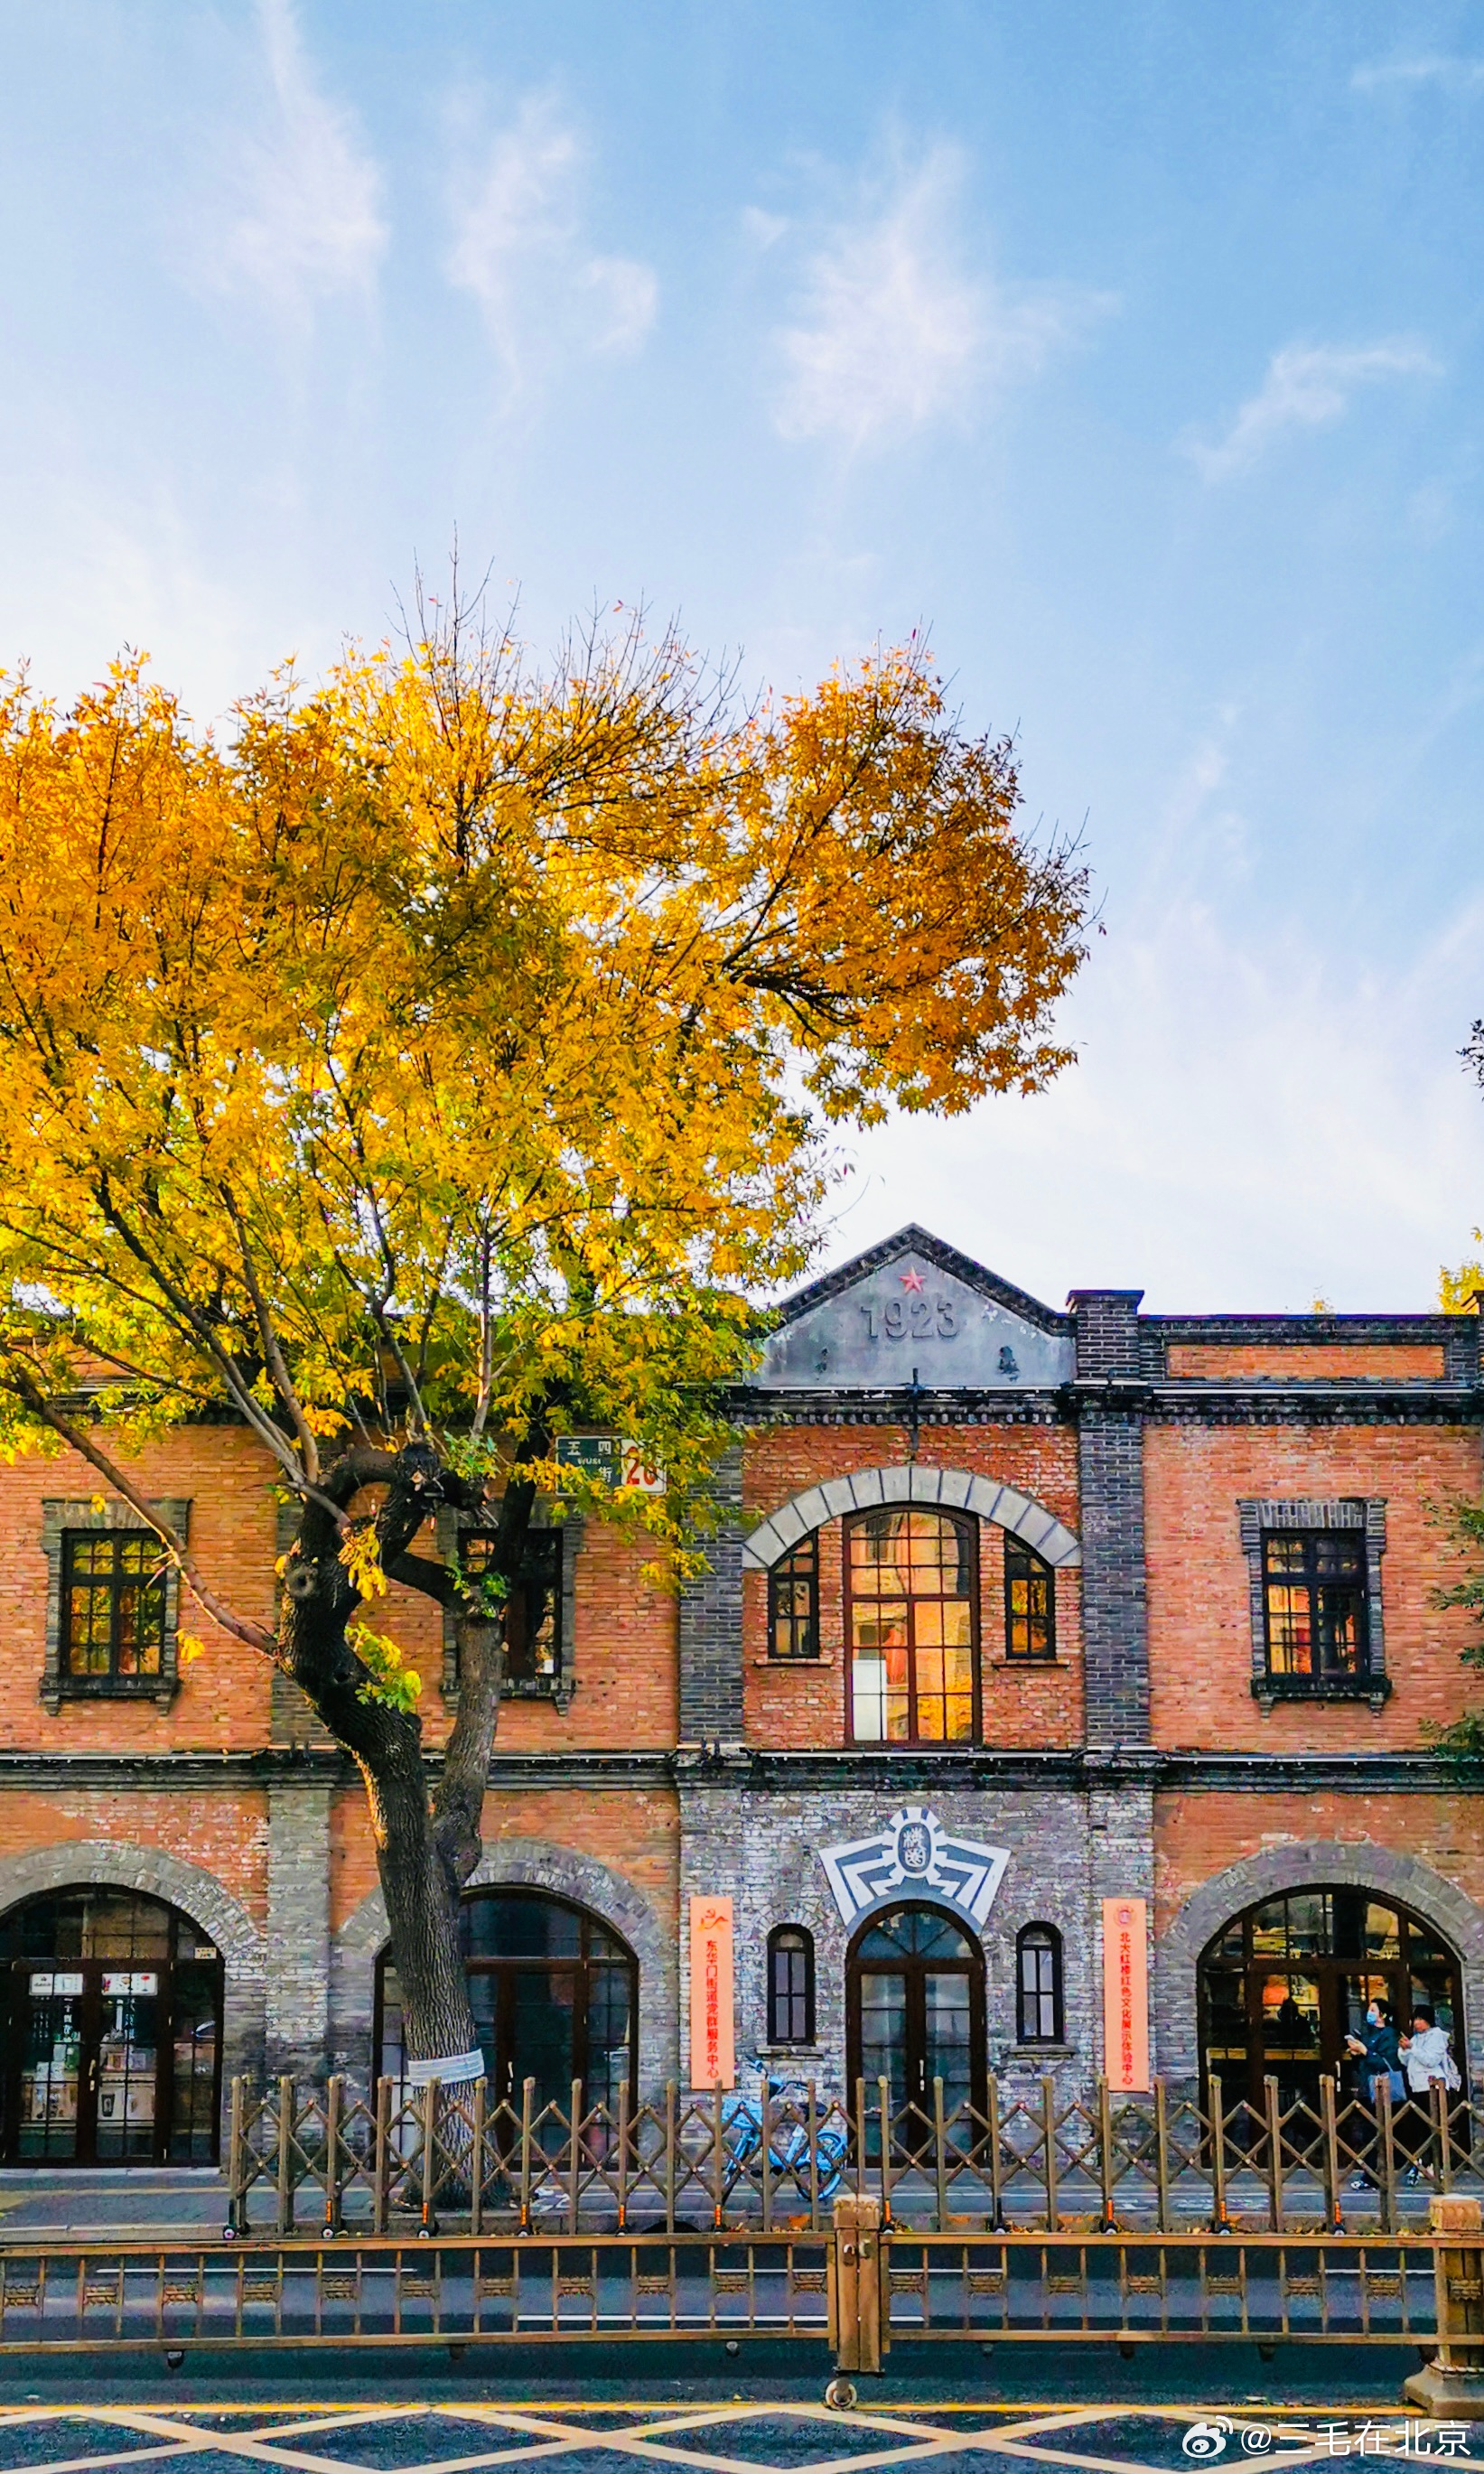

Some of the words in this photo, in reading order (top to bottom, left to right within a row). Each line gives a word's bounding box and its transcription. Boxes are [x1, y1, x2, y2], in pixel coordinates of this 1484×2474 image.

[860, 1299, 959, 1338] 1923
[567, 1441, 611, 1456] 五四
[705, 1939, 720, 2079] 东华门街道党群服务中心
[1119, 1932, 1134, 2086] 北大红楼红色文化展示体验中心
